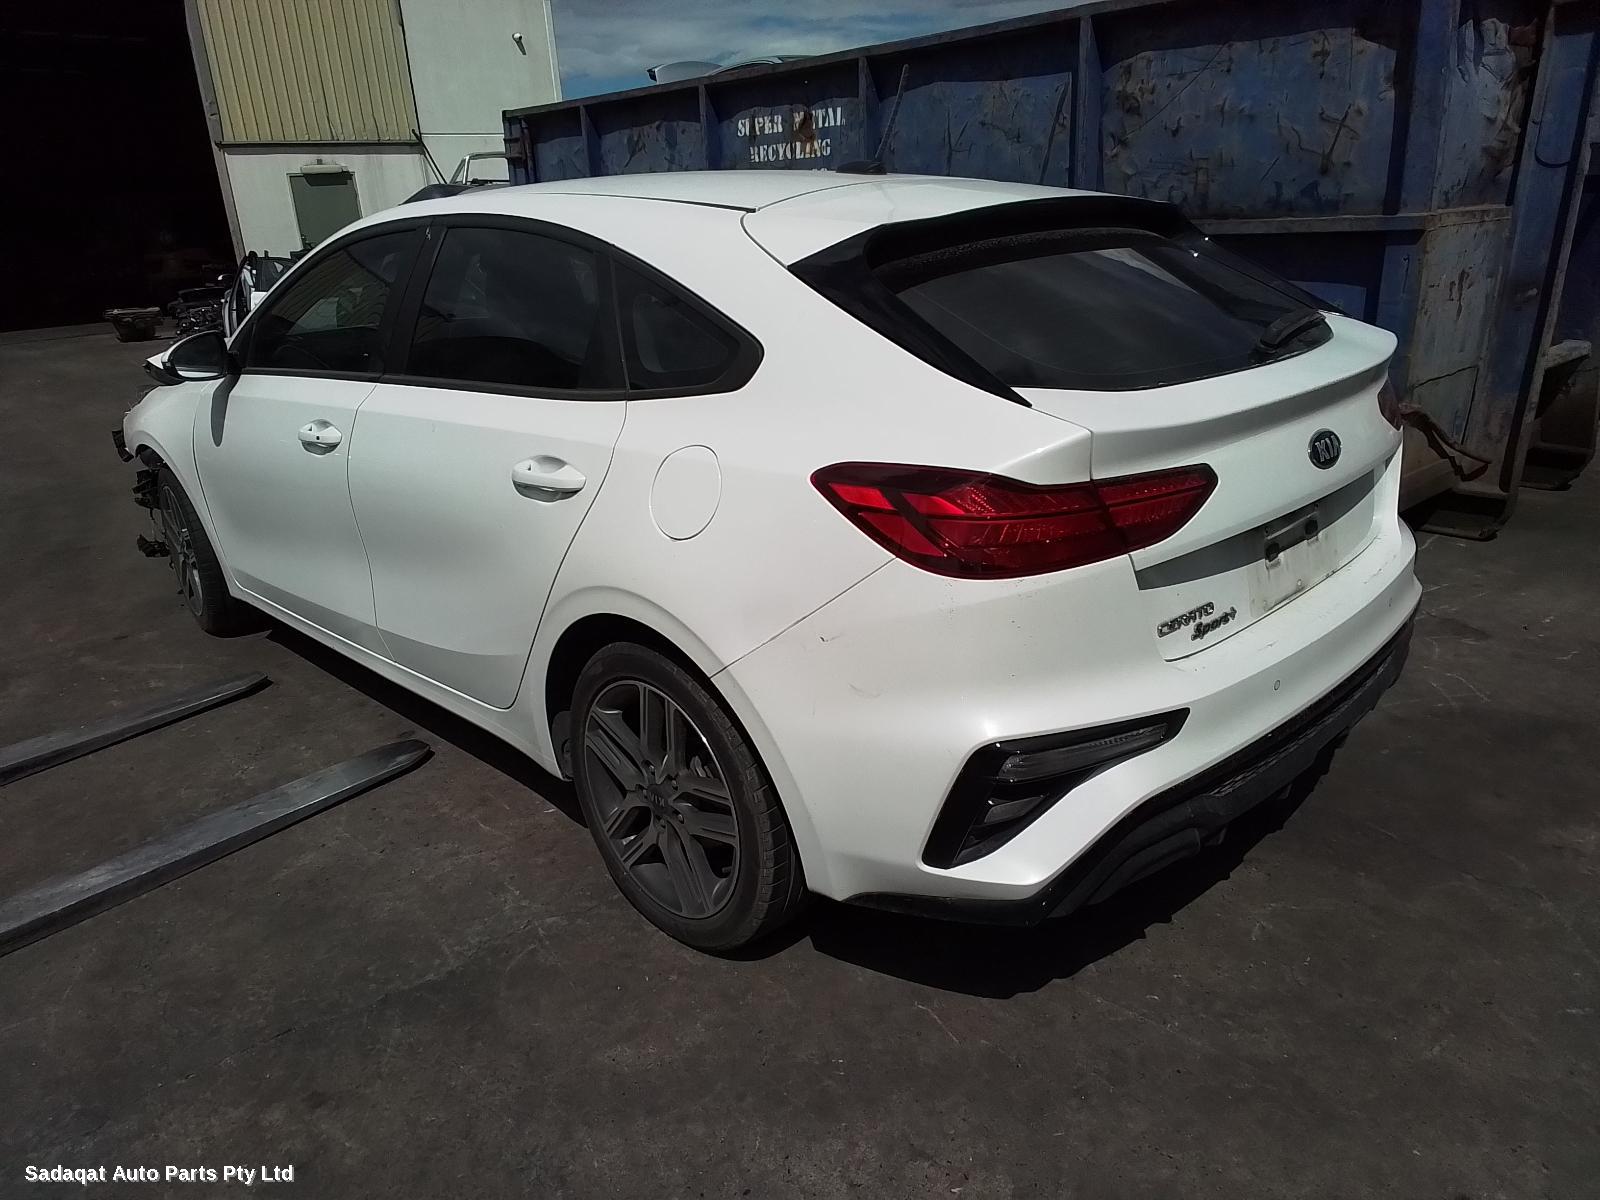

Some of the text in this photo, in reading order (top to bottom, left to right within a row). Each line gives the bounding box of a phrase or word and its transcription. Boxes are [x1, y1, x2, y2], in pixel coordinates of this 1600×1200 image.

[792, 106, 846, 131] MTAL
[750, 138, 831, 162] RECYCLING
[1314, 434, 1339, 462] KIA
